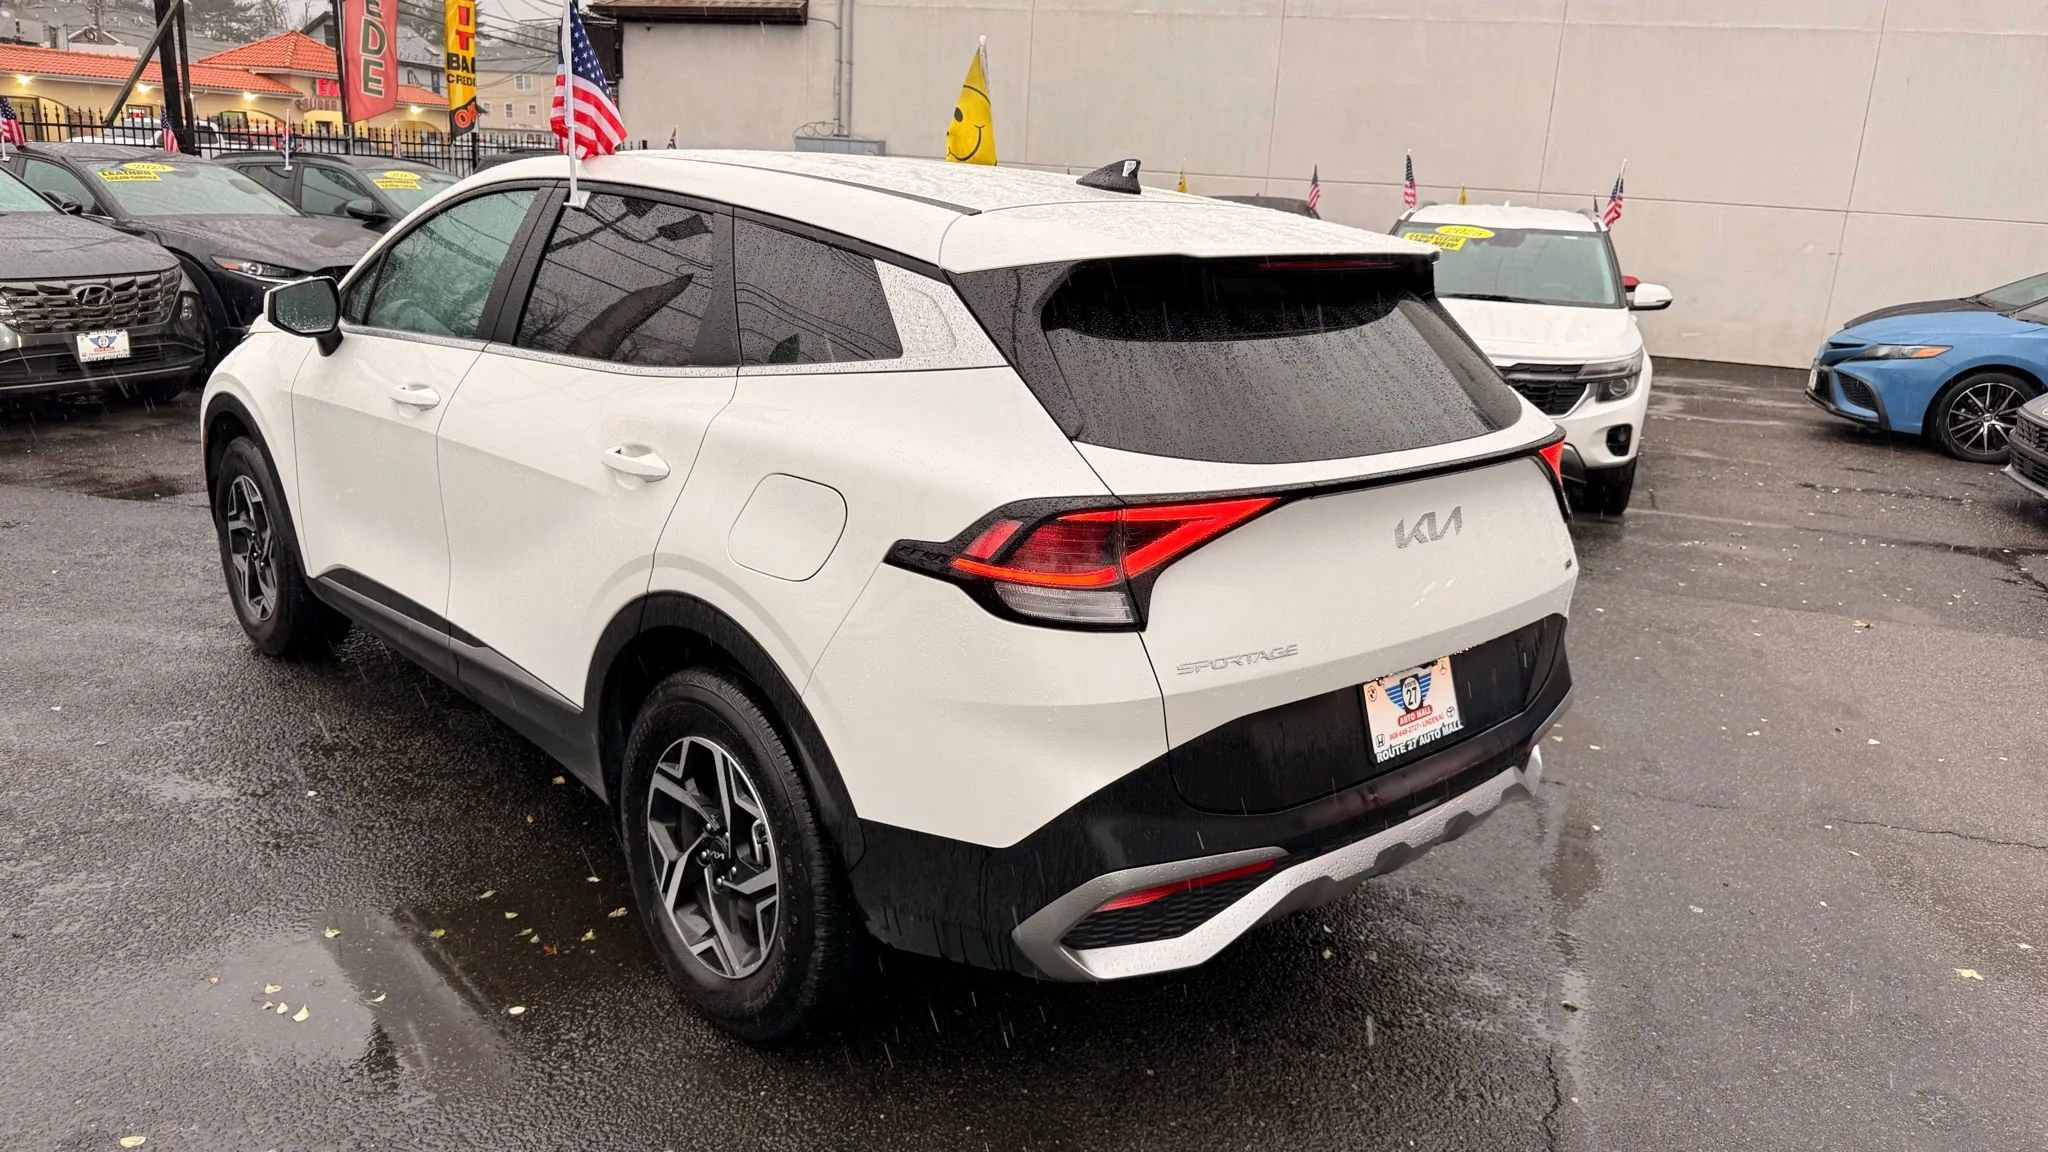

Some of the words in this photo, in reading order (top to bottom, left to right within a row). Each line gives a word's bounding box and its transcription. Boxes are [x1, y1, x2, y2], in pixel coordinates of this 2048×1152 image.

[1394, 505, 1463, 549] KIA
[1176, 644, 1299, 675] SPORTAGE
[1406, 686, 1418, 706] 27
[1399, 711, 1417, 727] AUTO
[1417, 705, 1432, 719] MALL
[1376, 743, 1407, 762] ROUTE
[1406, 738, 1419, 751] 27
[1419, 730, 1441, 745] AUTO
[1441, 720, 1464, 735] MALL
